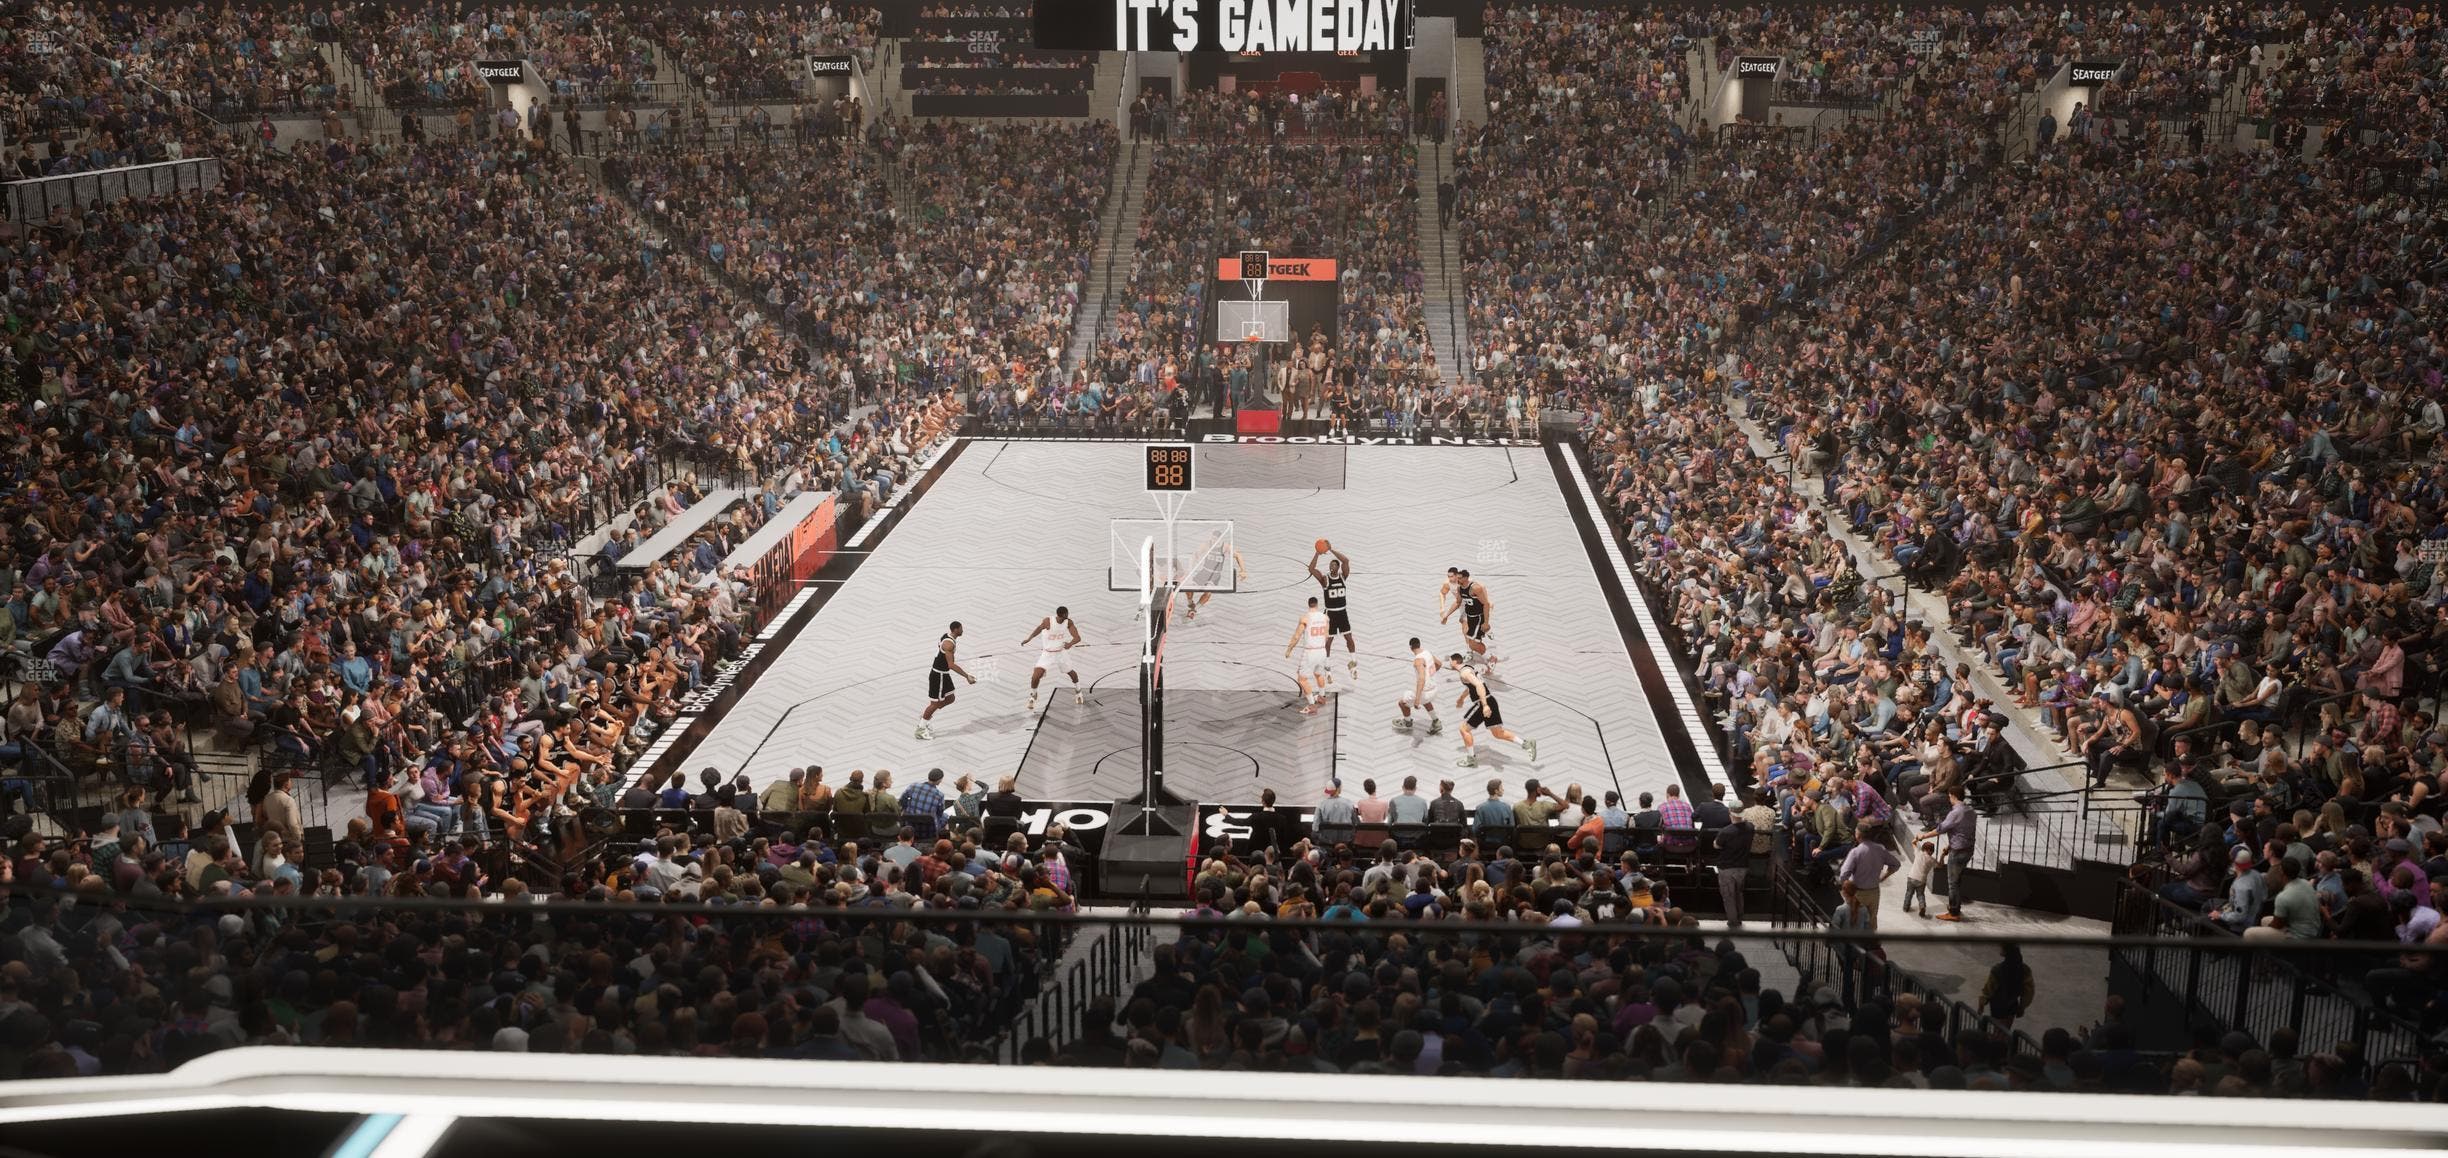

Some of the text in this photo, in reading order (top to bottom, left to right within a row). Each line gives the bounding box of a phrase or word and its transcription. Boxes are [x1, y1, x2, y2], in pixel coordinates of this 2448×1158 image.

[1116, 0, 1199, 51] IT'S
[1219, 0, 1398, 51] GAMEDAY
[480, 67, 520, 77] SEATGEEK
[813, 61, 850, 71] SEATGEEK
[1740, 62, 1777, 73] SEATGEEK
[1267, 263, 1311, 276] TGEEK
[1202, 433, 1541, 446] Brooklyn Nets
[1151, 450, 1187, 462] 88 88
[1155, 465, 1183, 485] 88
